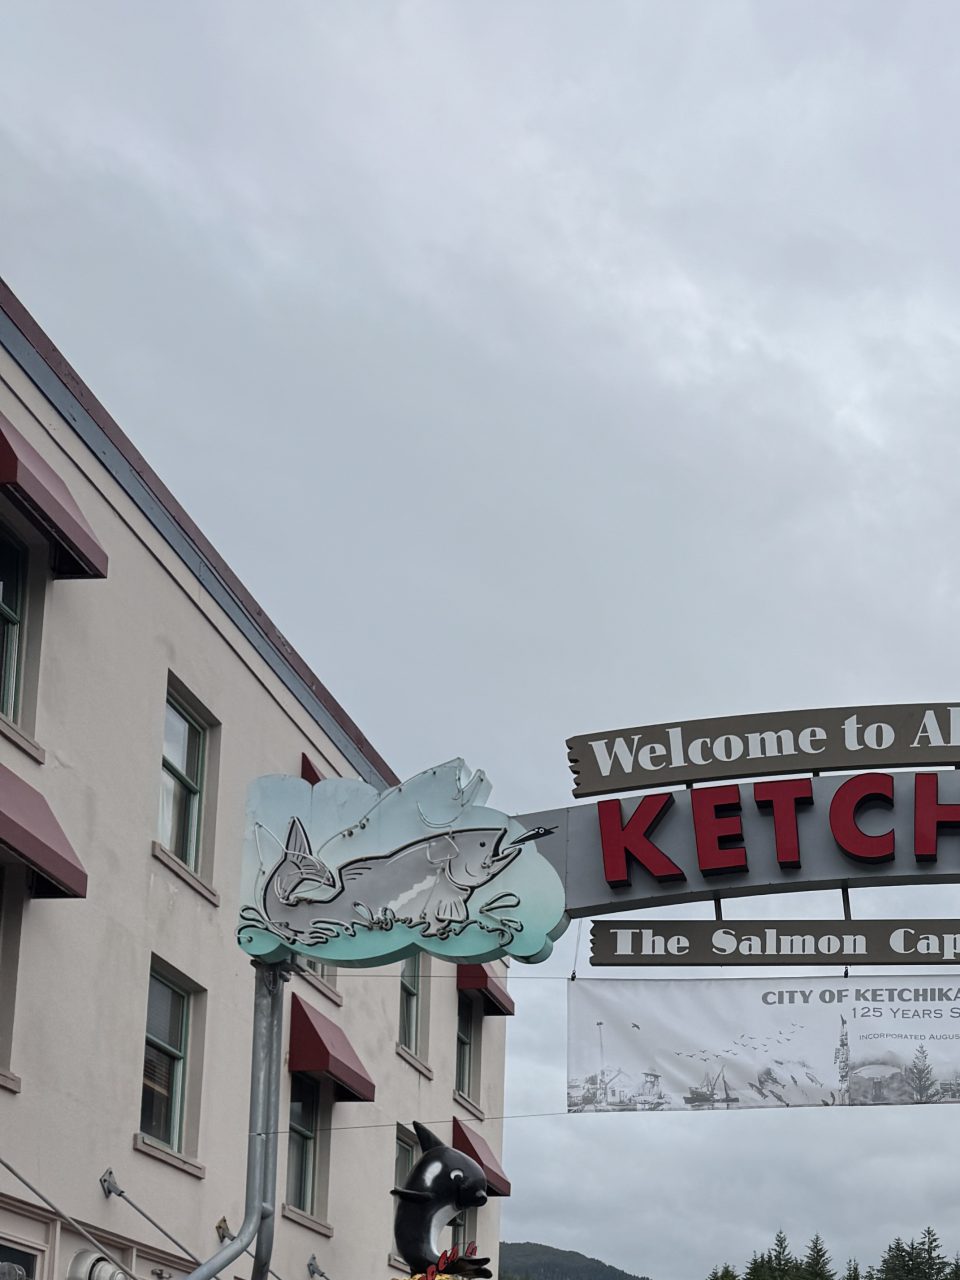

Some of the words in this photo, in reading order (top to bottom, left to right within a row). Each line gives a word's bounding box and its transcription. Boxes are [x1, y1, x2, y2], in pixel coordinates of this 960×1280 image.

[588, 726, 827, 776] Welcome
[841, 714, 895, 750] to
[609, 928, 690, 956] The
[711, 928, 867, 956] Salmon
[761, 989, 814, 1005] CITY
[818, 988, 849, 1004] OF
[850, 1006, 883, 1019] 125
[858, 1032, 926, 1041] INCORPORATED
